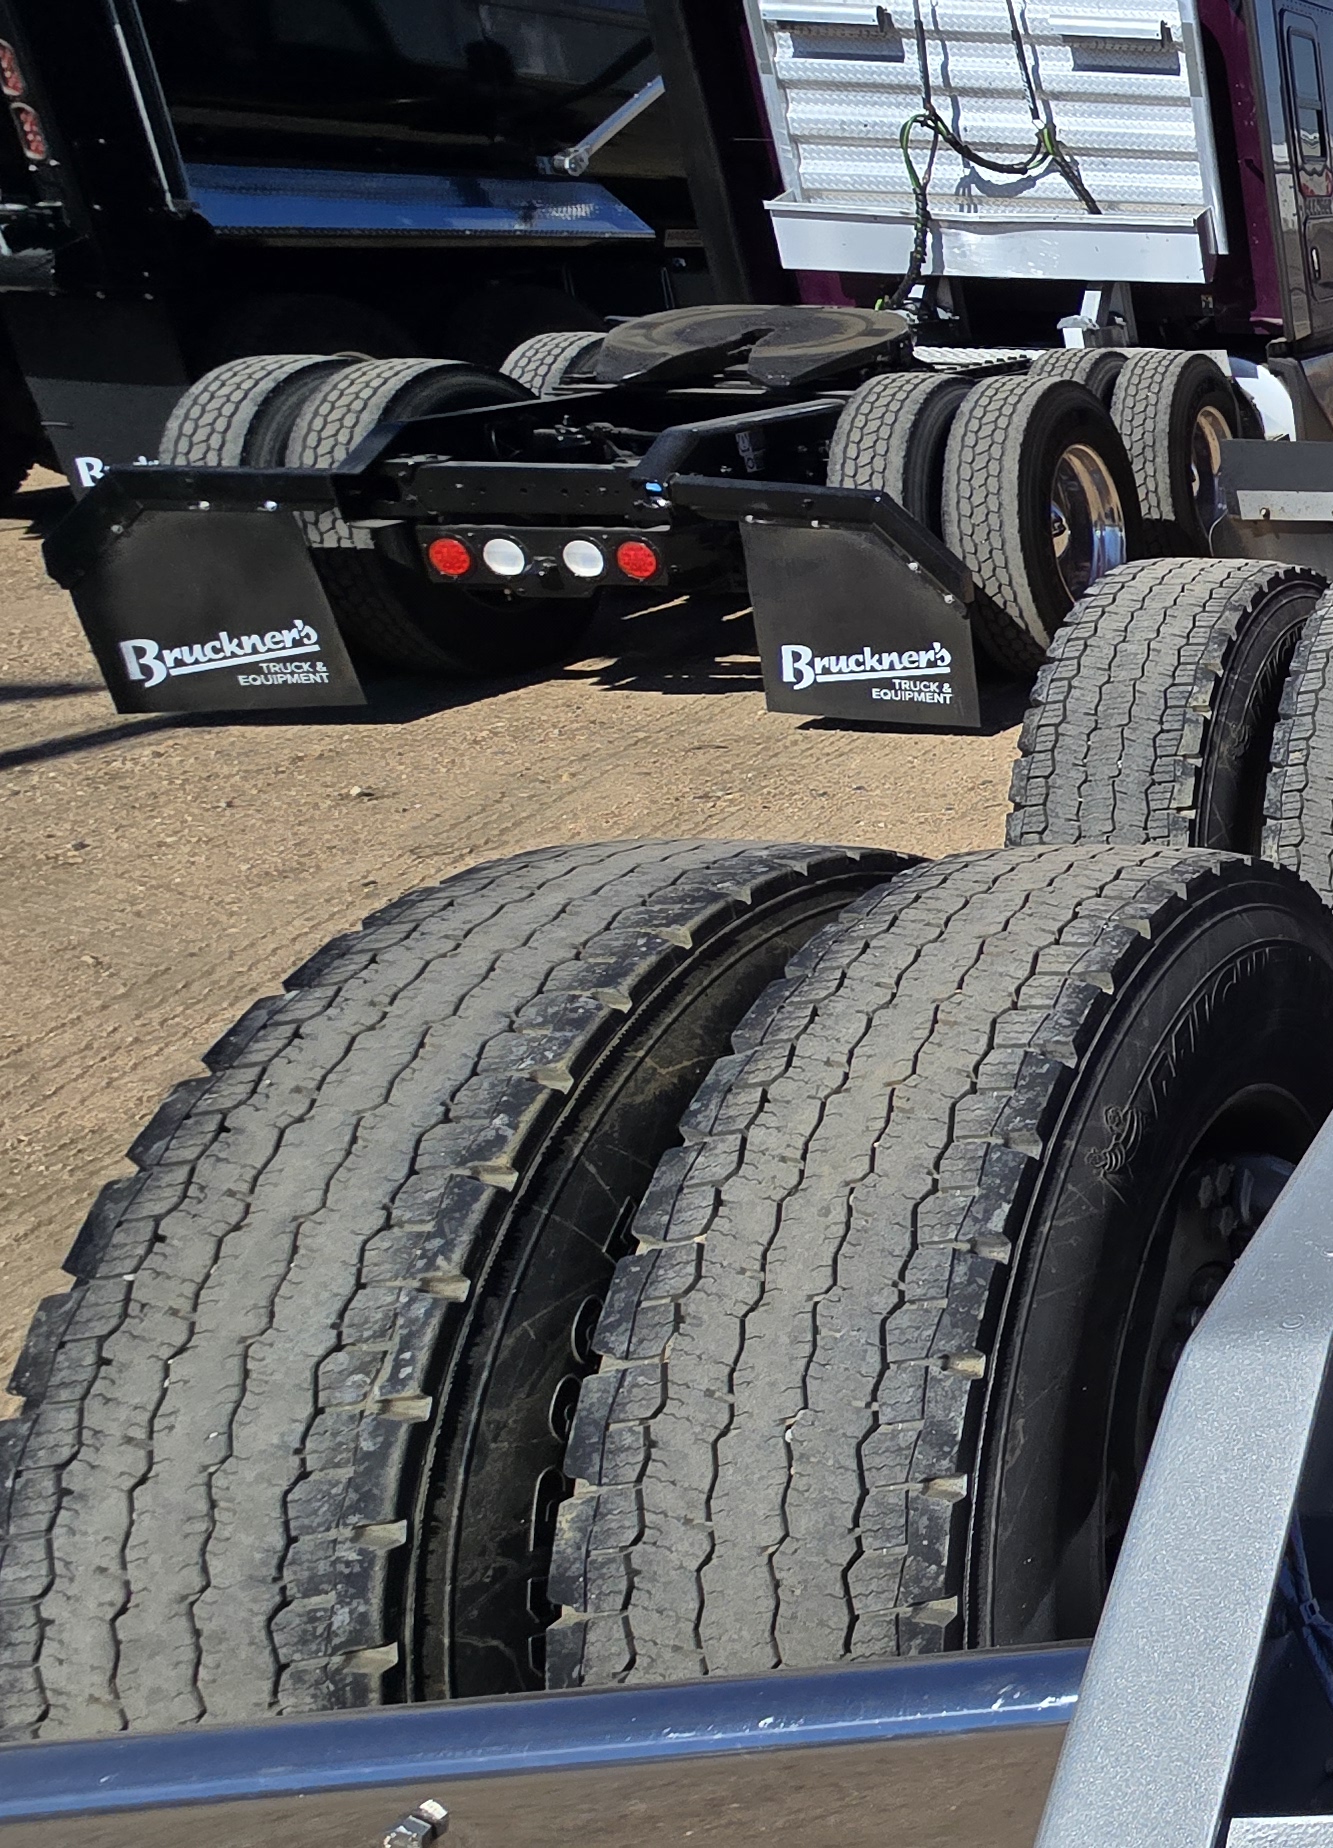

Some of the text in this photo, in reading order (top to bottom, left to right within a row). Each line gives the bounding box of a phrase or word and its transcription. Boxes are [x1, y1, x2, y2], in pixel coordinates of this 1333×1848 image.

[119, 619, 319, 688] Bruckner's
[259, 662, 327, 674] TRUCK &
[781, 641, 952, 690] Bruckner's
[238, 672, 329, 686] EQUIPMENT
[892, 678, 952, 693] TRUCK &
[871, 687, 953, 704] EQUIPMENT
